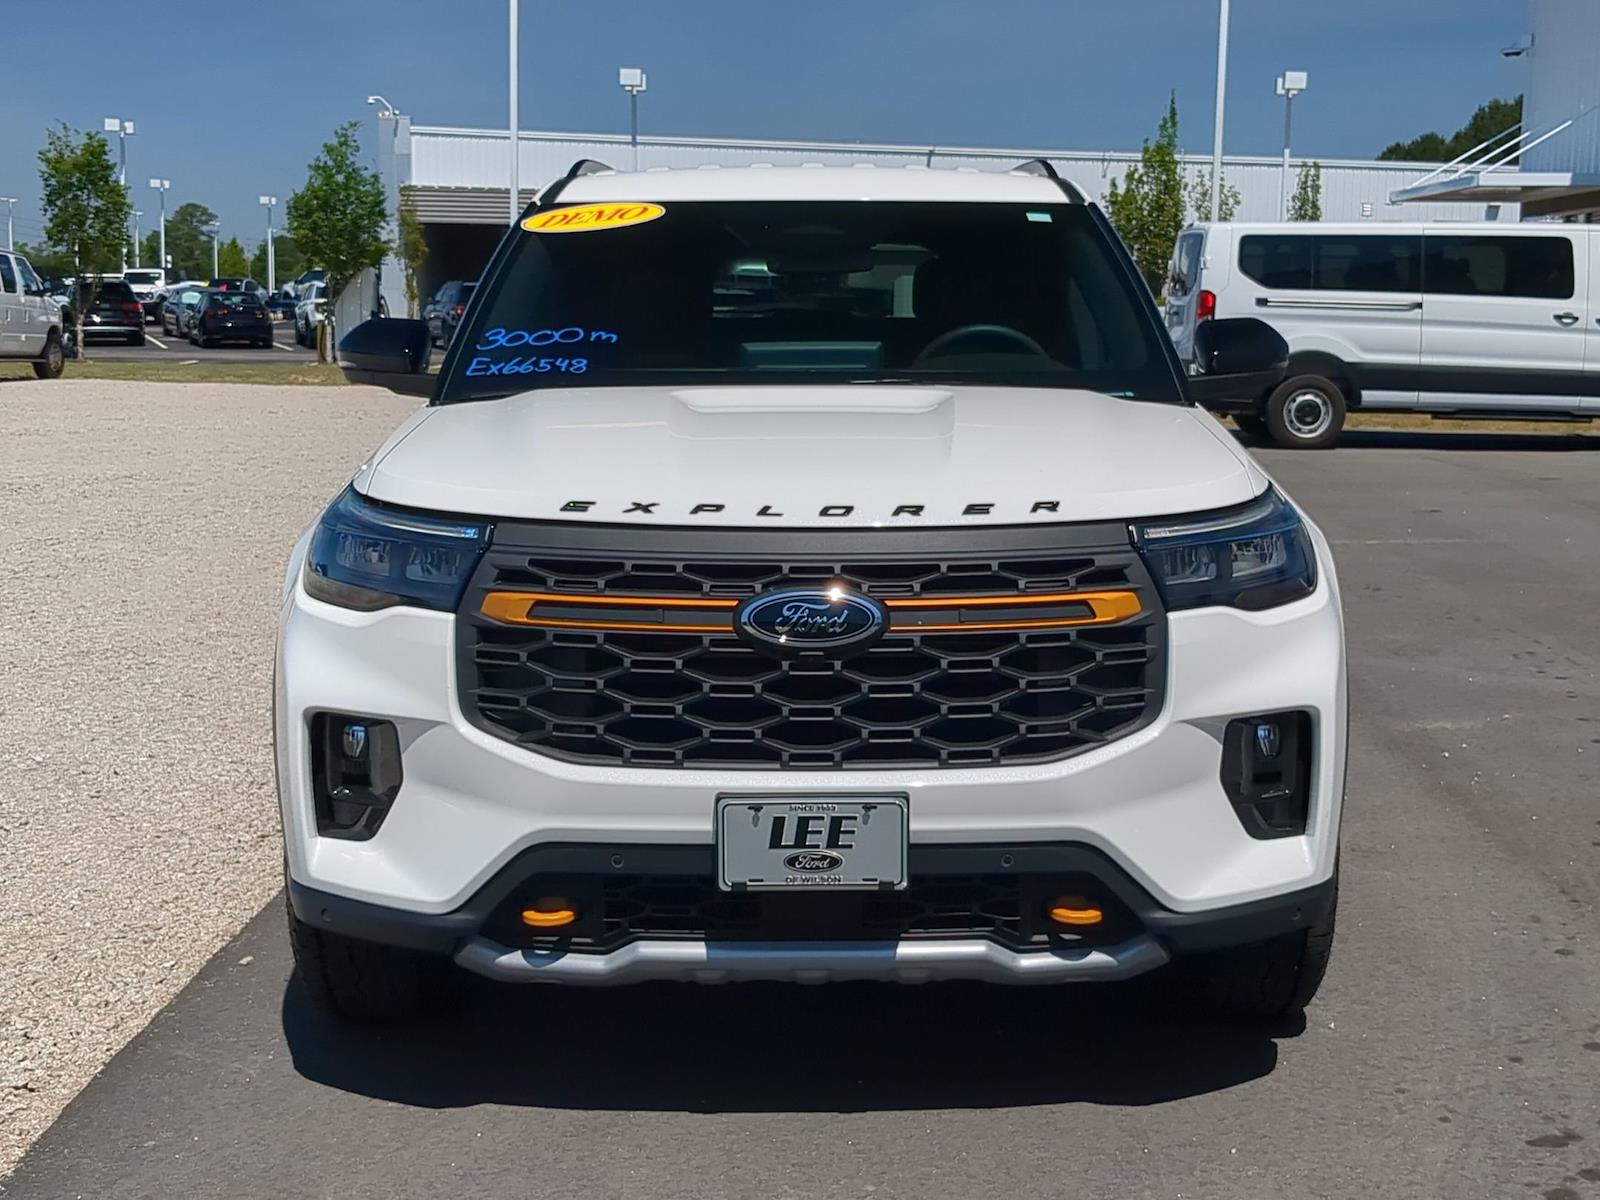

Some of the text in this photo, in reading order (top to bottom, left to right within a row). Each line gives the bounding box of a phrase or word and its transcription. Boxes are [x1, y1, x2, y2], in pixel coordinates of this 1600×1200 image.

[538, 206, 649, 228] DEMO
[476, 327, 584, 350] 3000
[559, 500, 1061, 517] EXPLORER
[774, 602, 849, 634] Ford
[789, 804, 814, 812] SINCE
[767, 815, 859, 850] LEE
[795, 854, 830, 868] Ford
[785, 875, 843, 884] OF WILSON
